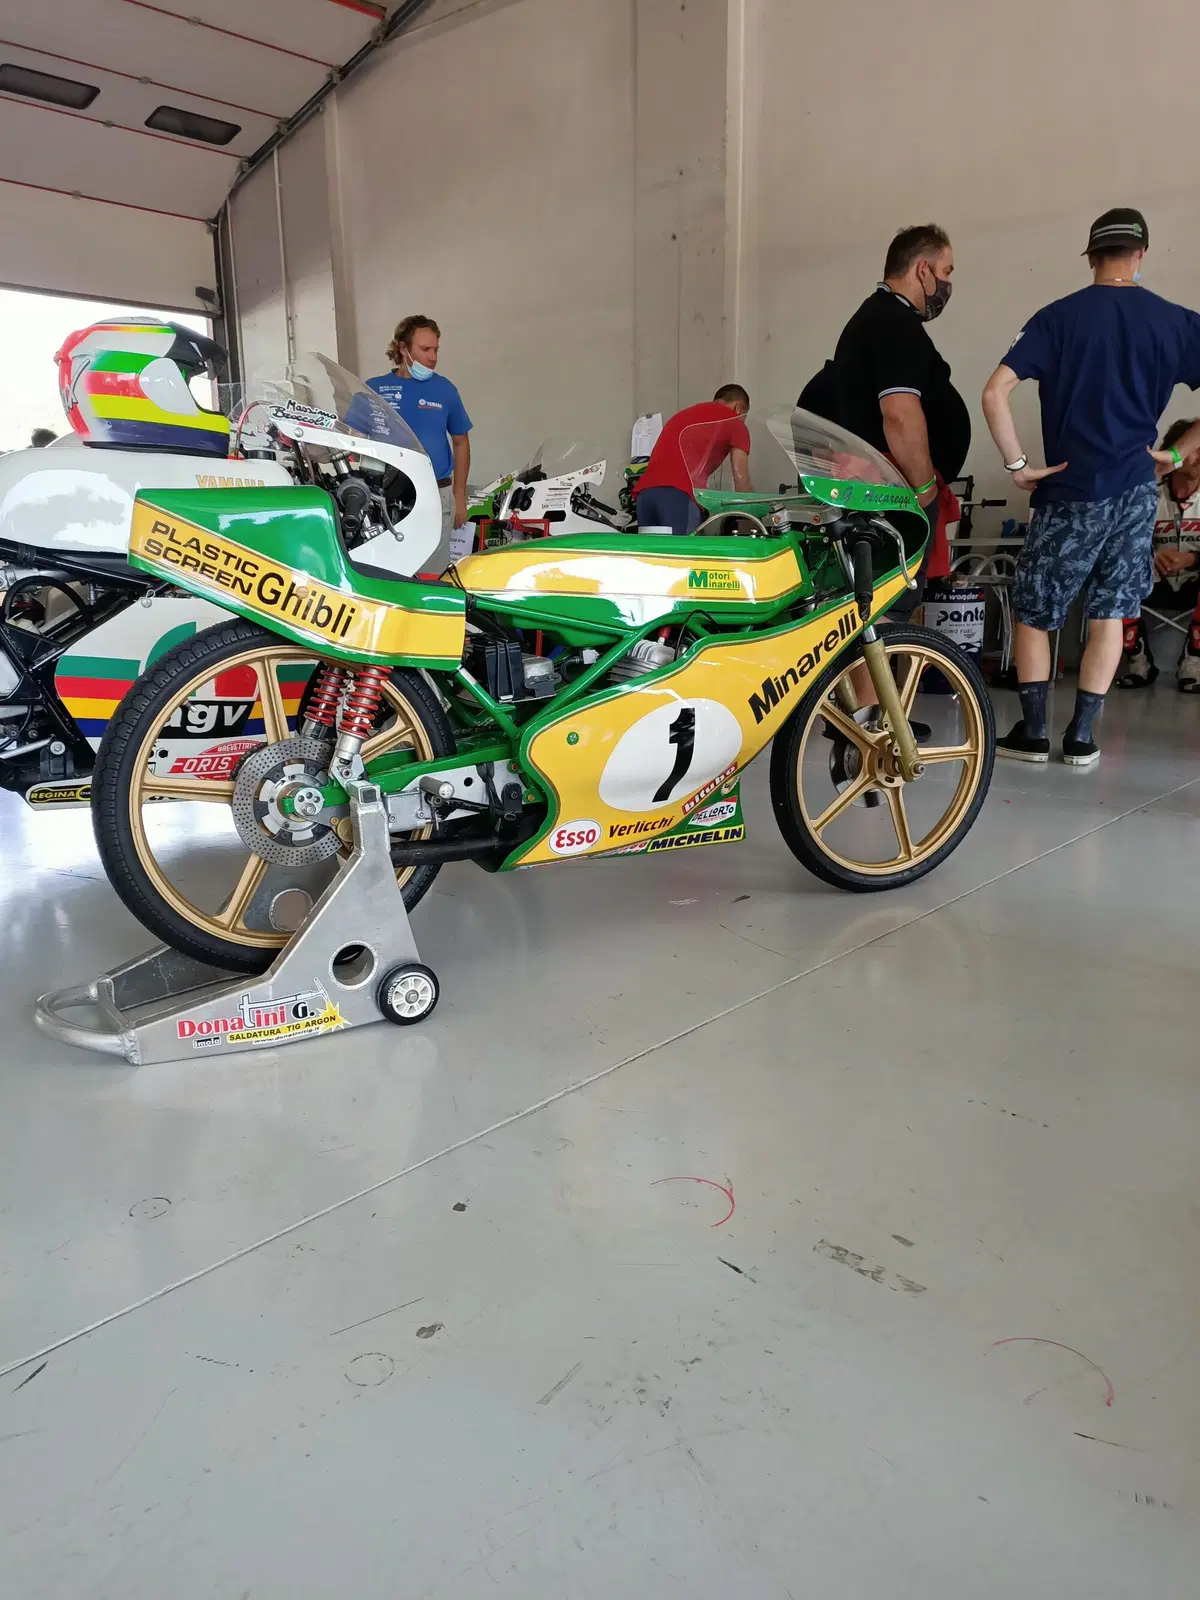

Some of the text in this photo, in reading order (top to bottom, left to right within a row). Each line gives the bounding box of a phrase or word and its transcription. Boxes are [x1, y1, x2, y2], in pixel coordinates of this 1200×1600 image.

[286, 399, 337, 420] Massimo
[195, 474, 265, 488] YAMAHA
[151, 520, 260, 578] PLASTIC
[144, 538, 356, 638] SCREEN Ghibli
[748, 608, 857, 725] Minarelli
[651, 707, 696, 803] 1
[31, 791, 75, 799] REGINA
[683, 766, 736, 813] bitubo
[609, 815, 676, 839] Verlicchi
[650, 827, 743, 850] MICHELIN
[177, 993, 315, 1040] Donatini G.
[229, 1014, 336, 1041] SALDATURA TIG ARGON
